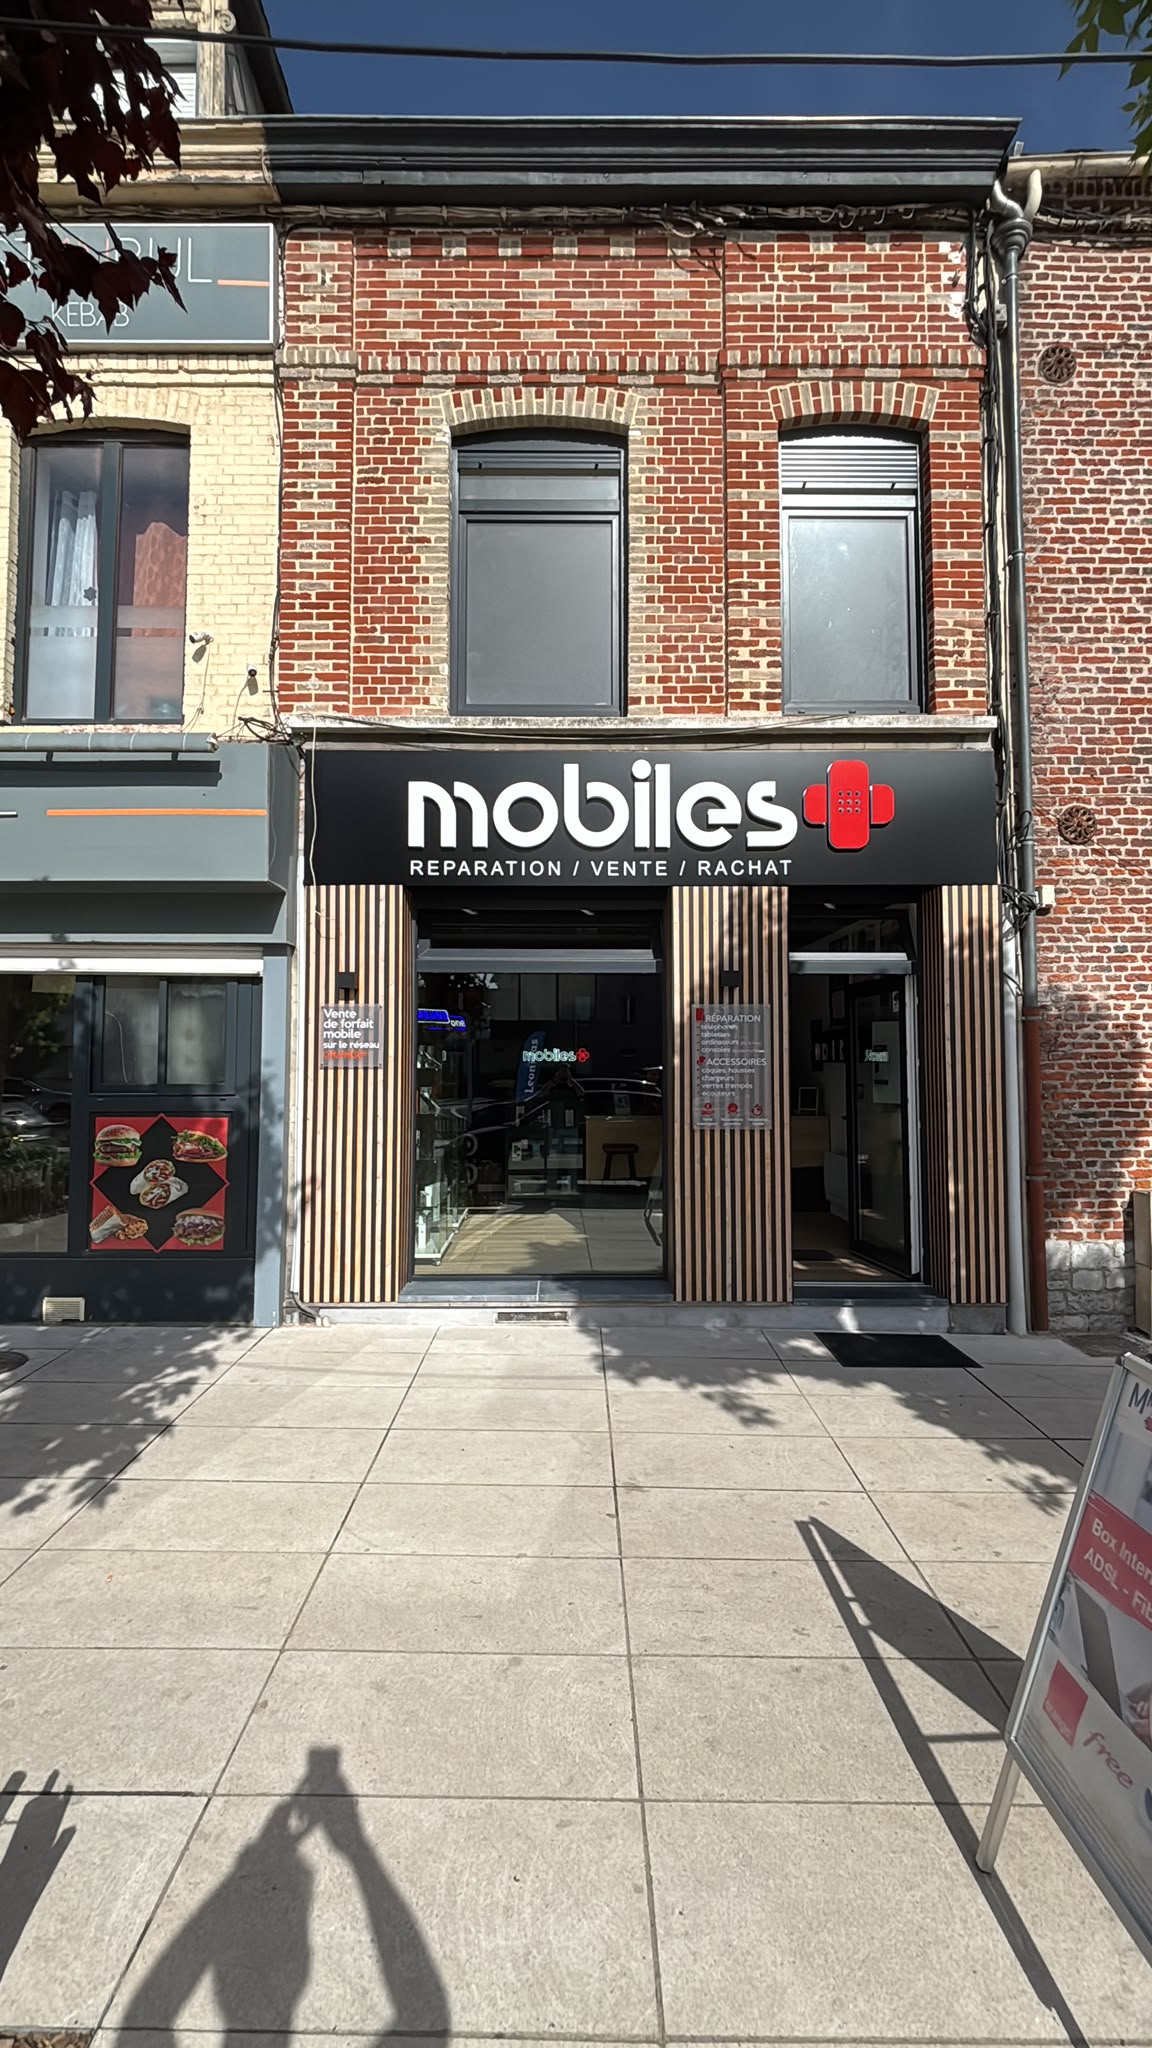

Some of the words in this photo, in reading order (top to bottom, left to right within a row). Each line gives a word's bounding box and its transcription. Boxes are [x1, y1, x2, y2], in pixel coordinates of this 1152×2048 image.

[407, 759, 798, 849] mobiles
[410, 859, 562, 877] REPARATION
[573, 859, 581, 877] /
[591, 859, 668, 877] VENTE
[679, 859, 687, 877] /
[697, 859, 793, 877] RACHAT
[323, 1008, 357, 1018] Vente
[705, 1012, 761, 1022] RÉPARATION
[323, 1019, 338, 1028] de
[340, 1018, 374, 1028] forfait
[323, 1029, 362, 1039] mobile
[338, 1041, 348, 1049] le
[349, 1041, 380, 1049] réseau
[522, 1048, 577, 1062] mobiles
[706, 1058, 767, 1066] ACCESSOIRES
[1091, 1517, 1118, 1552] Box
[1083, 1546, 1119, 1591] ADSL
[1082, 1730, 1134, 1790] free
